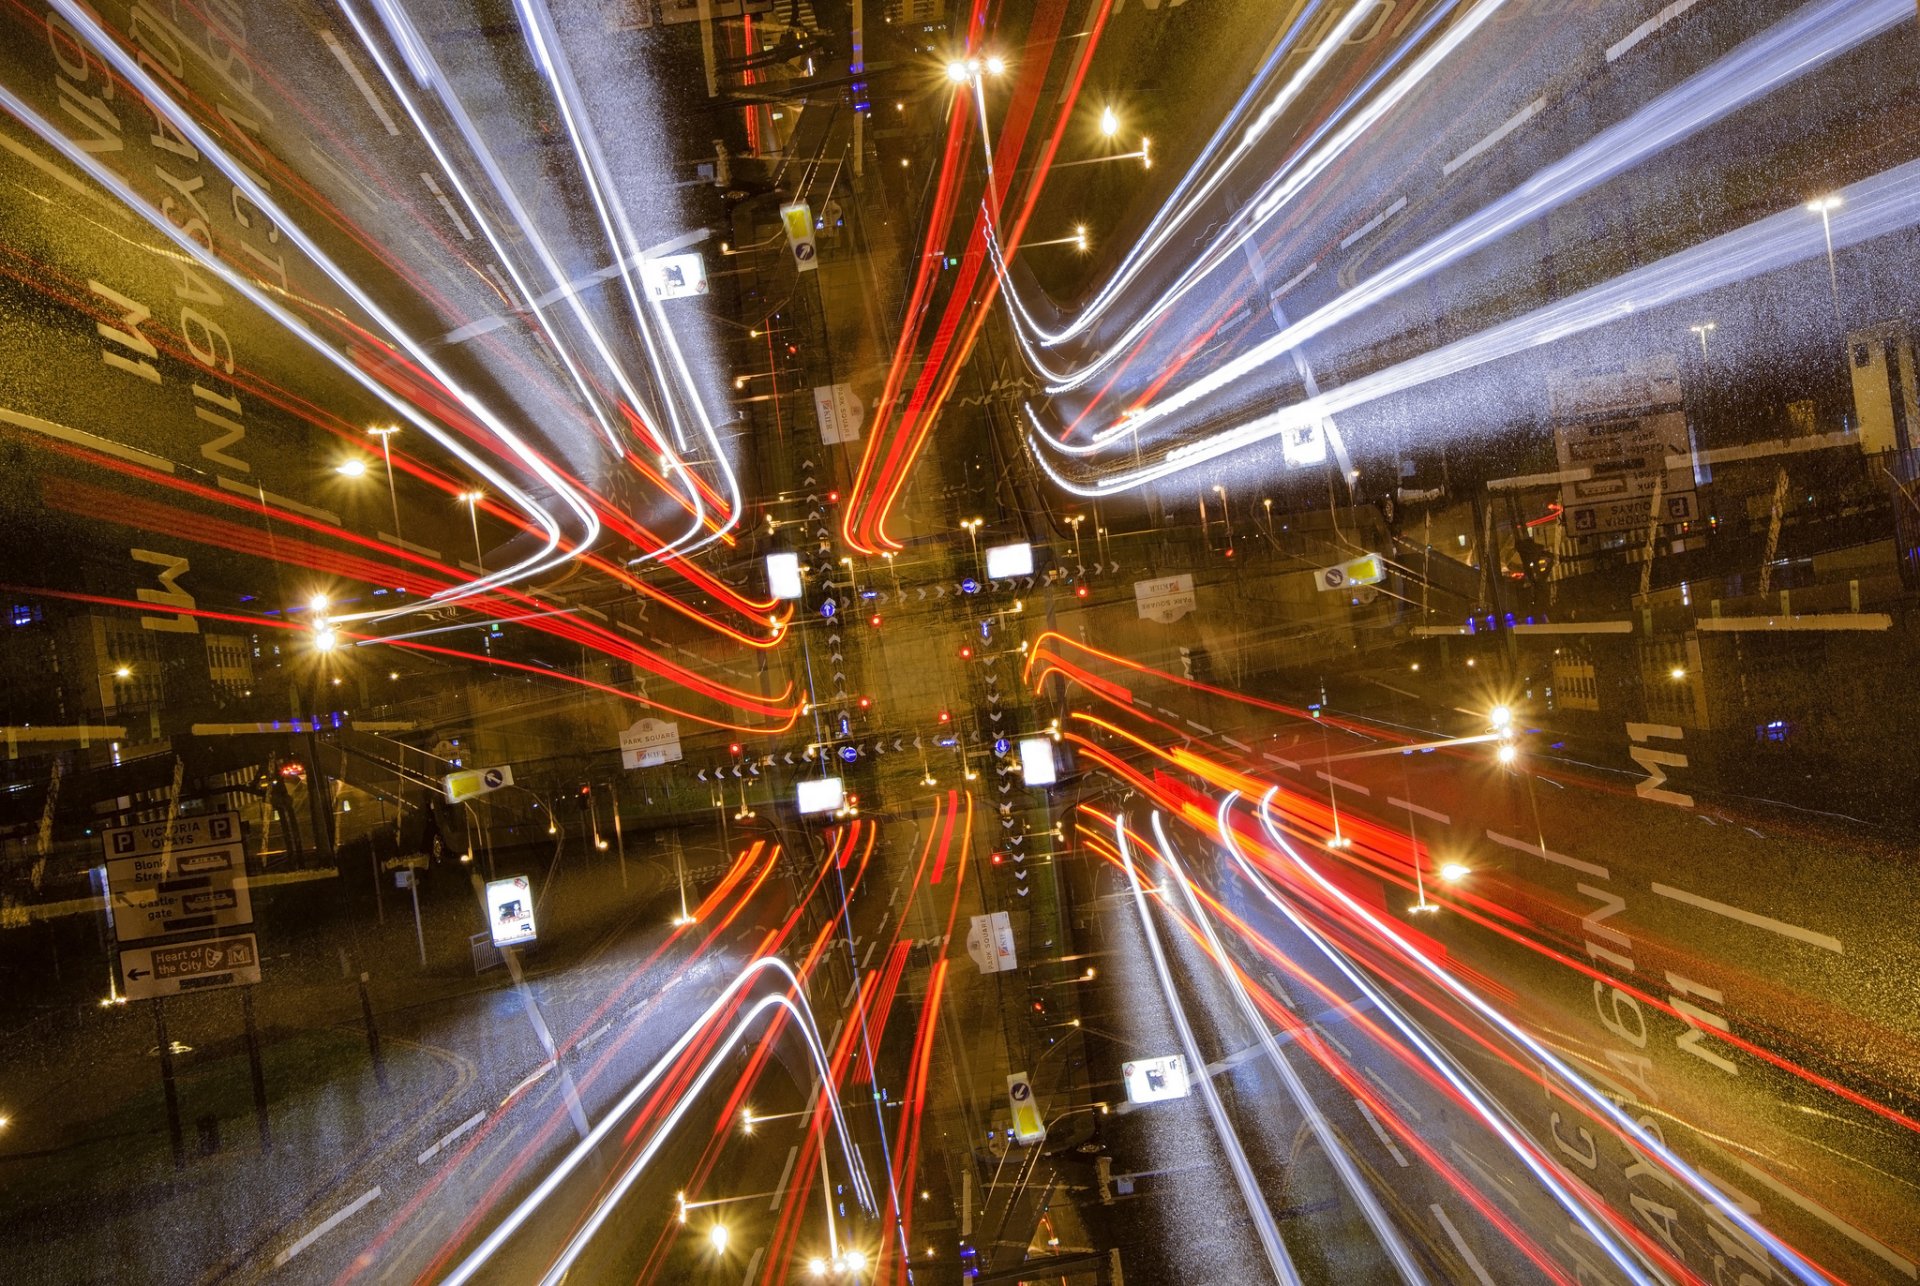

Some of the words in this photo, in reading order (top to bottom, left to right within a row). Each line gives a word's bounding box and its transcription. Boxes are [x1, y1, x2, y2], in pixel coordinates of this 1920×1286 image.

[88, 279, 162, 385] M1
[837, 386, 846, 405] PARK
[840, 408, 850, 439] SQUARE
[1604, 513, 1663, 528] CTORIA
[110, 548, 199, 634] M1
[623, 737, 642, 746] PARK
[645, 731, 676, 742] SQUARE
[1625, 722, 1694, 807] M1
[147, 910, 173, 922] gate
[981, 919, 991, 948] SQUARE
[156, 949, 187, 963] Heart
[189, 948, 203, 960] of
[986, 952, 995, 970] PARK
[158, 964, 177, 977] the
[179, 960, 203, 975] City
[1665, 970, 1738, 1075] M1
